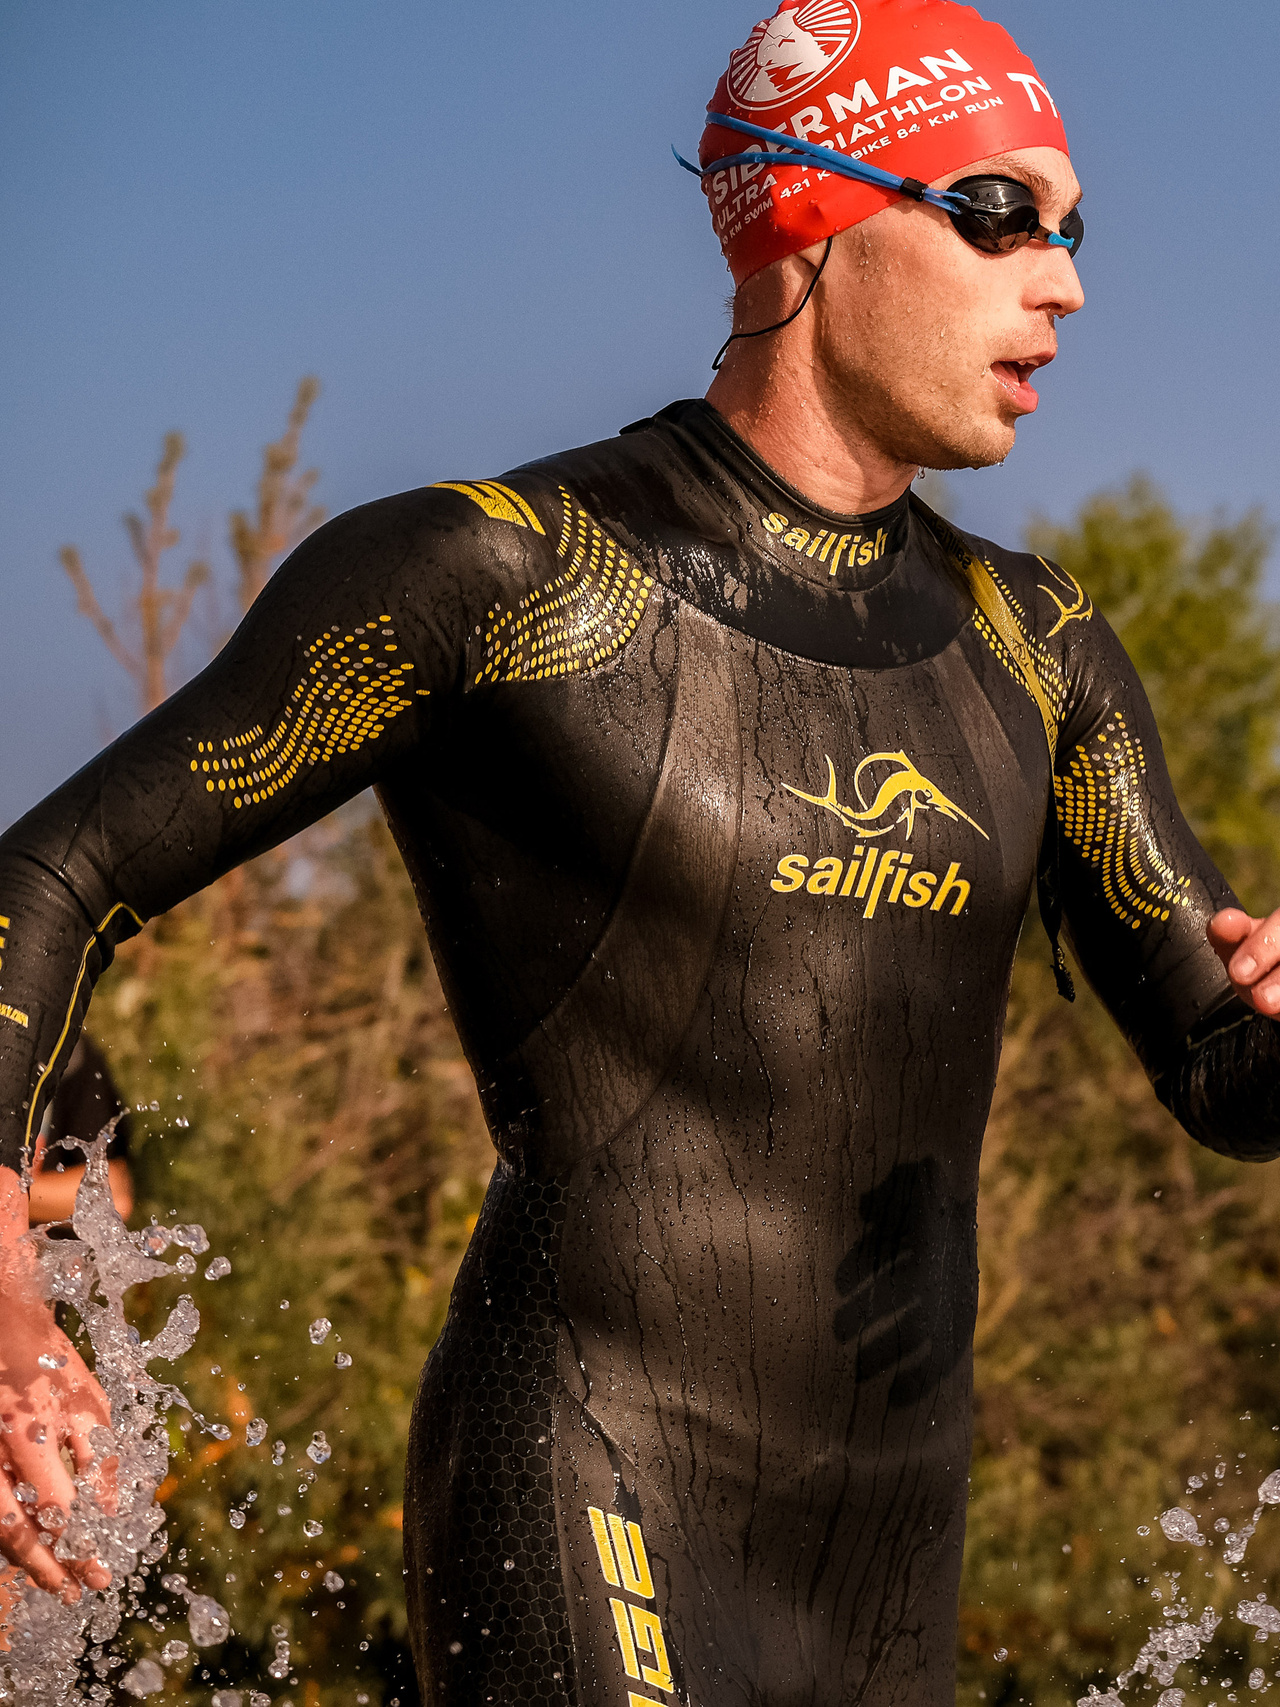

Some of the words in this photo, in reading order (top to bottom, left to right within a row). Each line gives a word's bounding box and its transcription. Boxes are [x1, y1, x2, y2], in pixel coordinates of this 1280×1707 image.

[717, 173, 778, 230] ULTRA
[801, 76, 993, 172] IATHLON
[729, 221, 742, 238] KM
[744, 197, 774, 224] SWIM
[780, 178, 811, 199] 421
[850, 135, 892, 160] BIKE
[897, 123, 921, 139] 84
[928, 110, 959, 127] KM
[964, 96, 1004, 114] RUN
[762, 512, 888, 576] sailfish
[770, 845, 971, 919] sailfish
